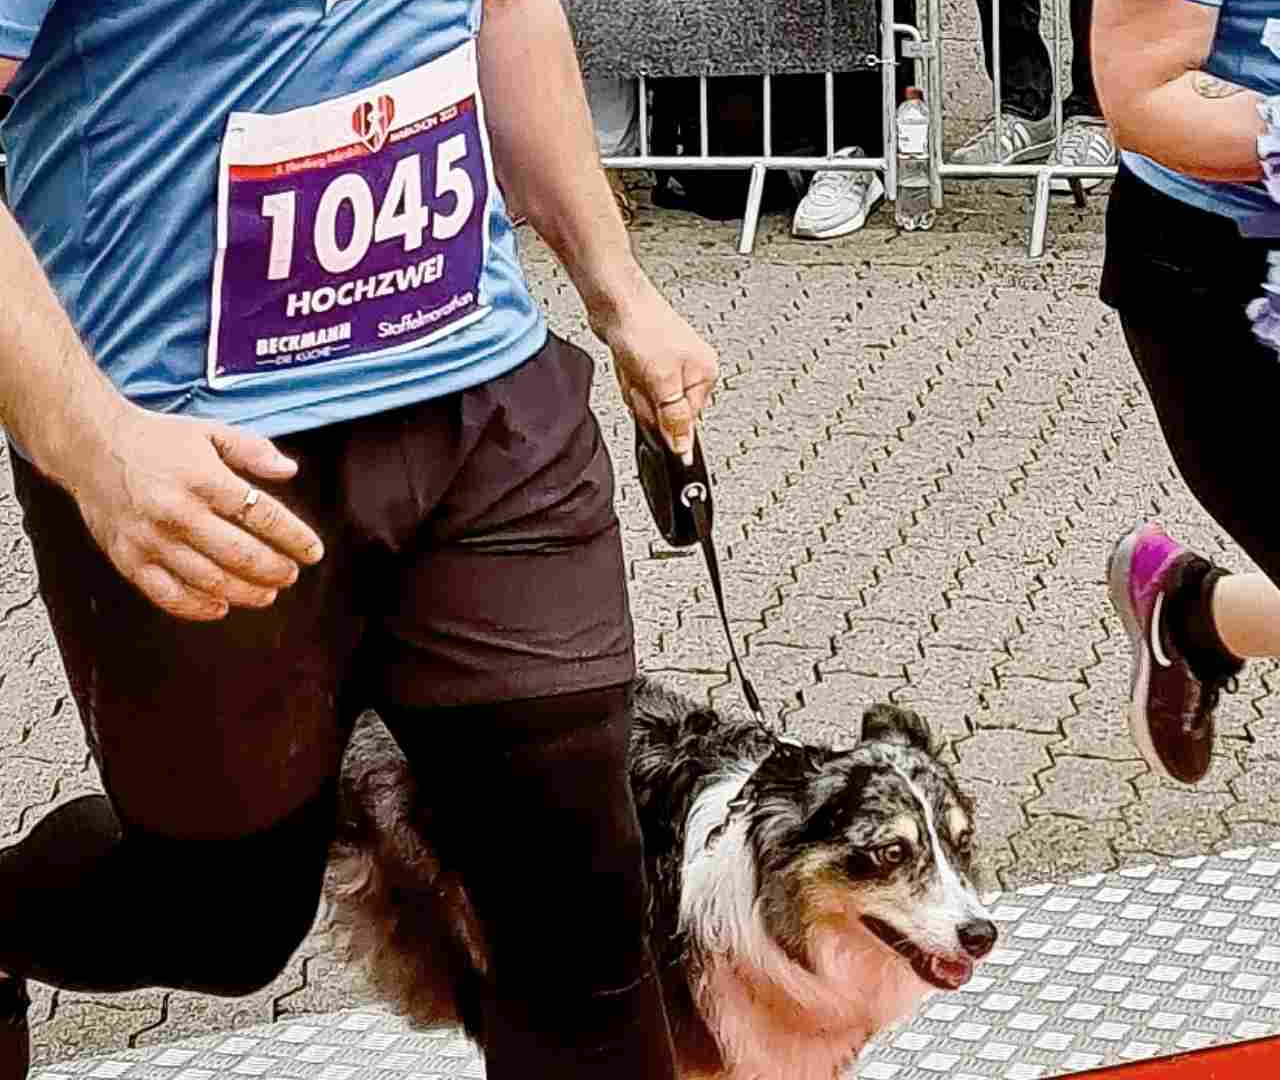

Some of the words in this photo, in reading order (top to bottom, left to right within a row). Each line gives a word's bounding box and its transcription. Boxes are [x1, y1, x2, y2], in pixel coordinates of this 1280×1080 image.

[261, 134, 475, 281] 1045
[286, 253, 444, 317] HOCHZWEI
[256, 322, 352, 356] BECKMANN
[378, 291, 474, 338] Staffelmarathon
